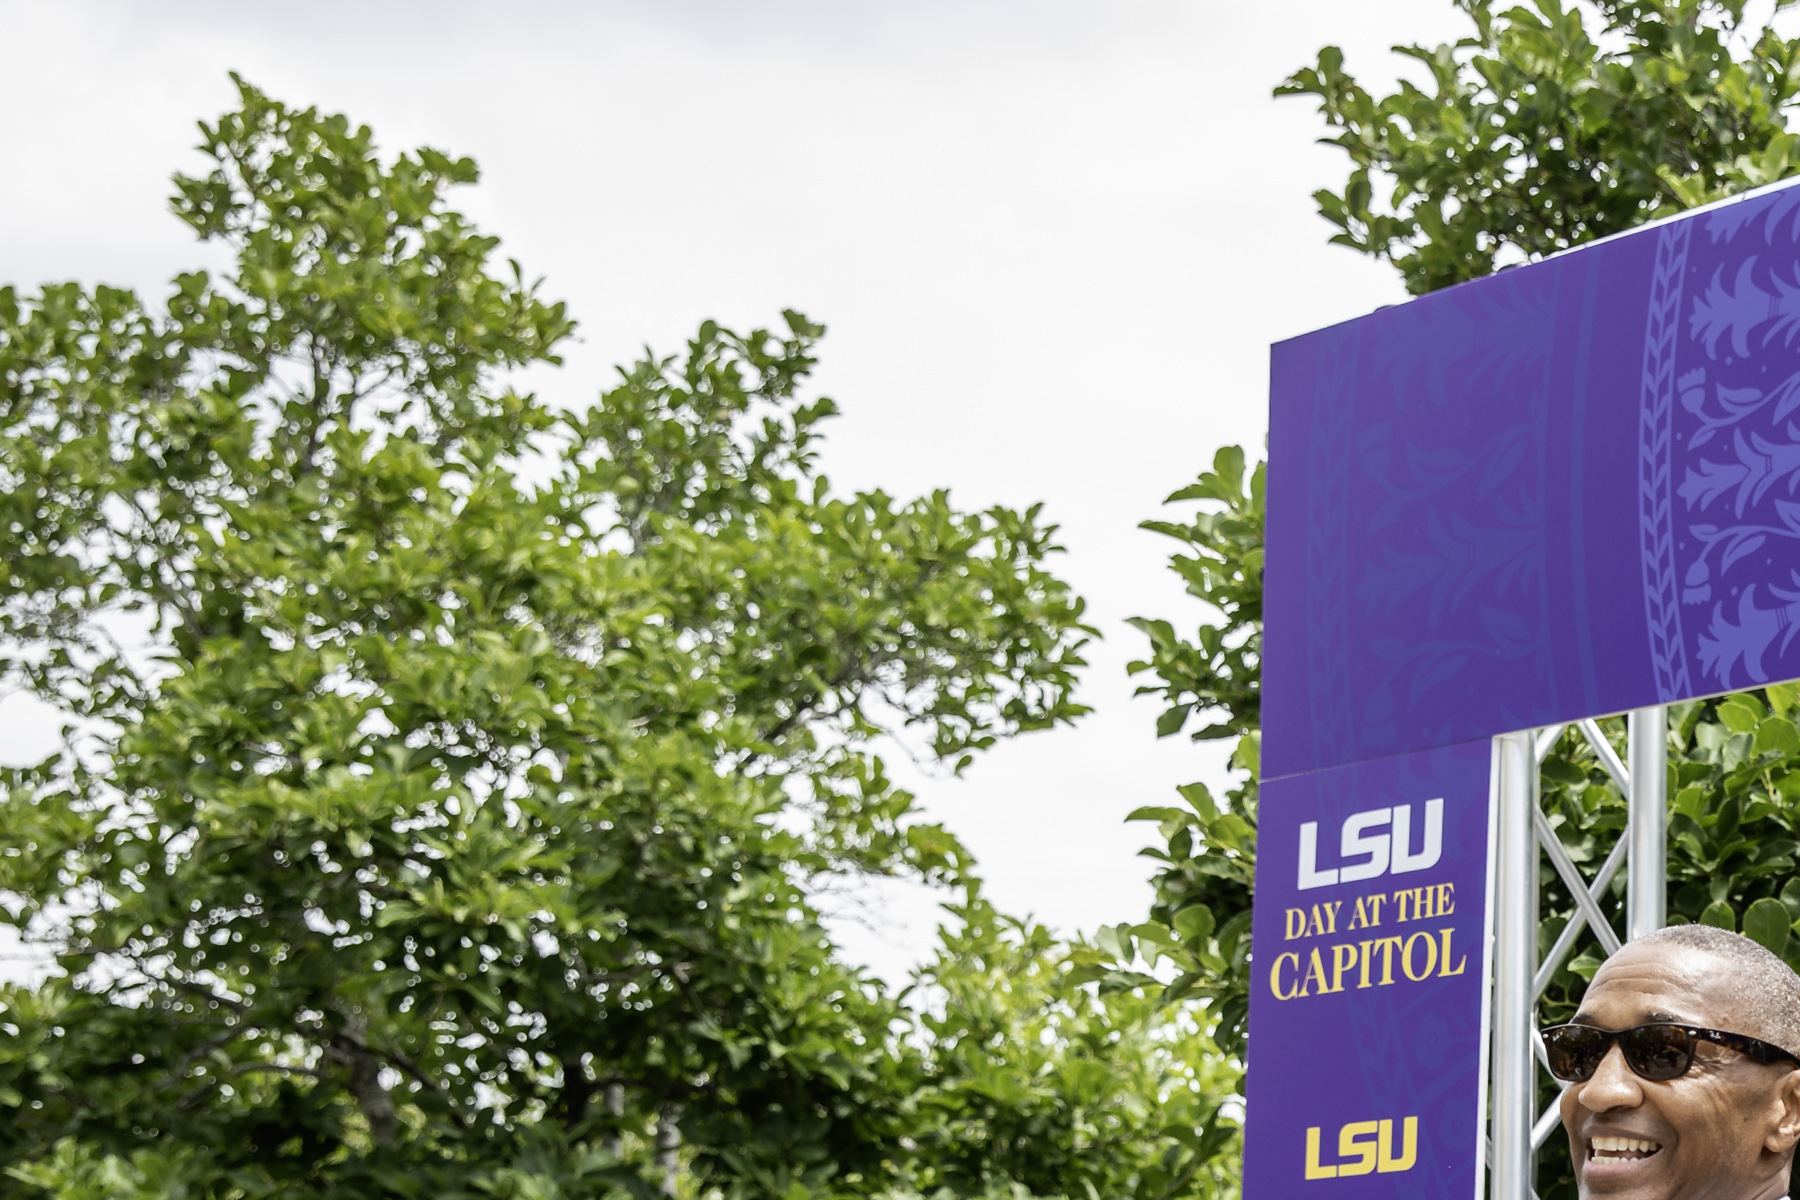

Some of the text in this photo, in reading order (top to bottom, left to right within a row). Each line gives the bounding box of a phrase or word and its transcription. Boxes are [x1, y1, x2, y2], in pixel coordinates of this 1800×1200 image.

[1297, 796, 1445, 891] LSU
[1284, 882, 1456, 942] DAY AT THE
[1268, 927, 1468, 1002] CAPITOL
[1304, 1115, 1419, 1181] LSU
